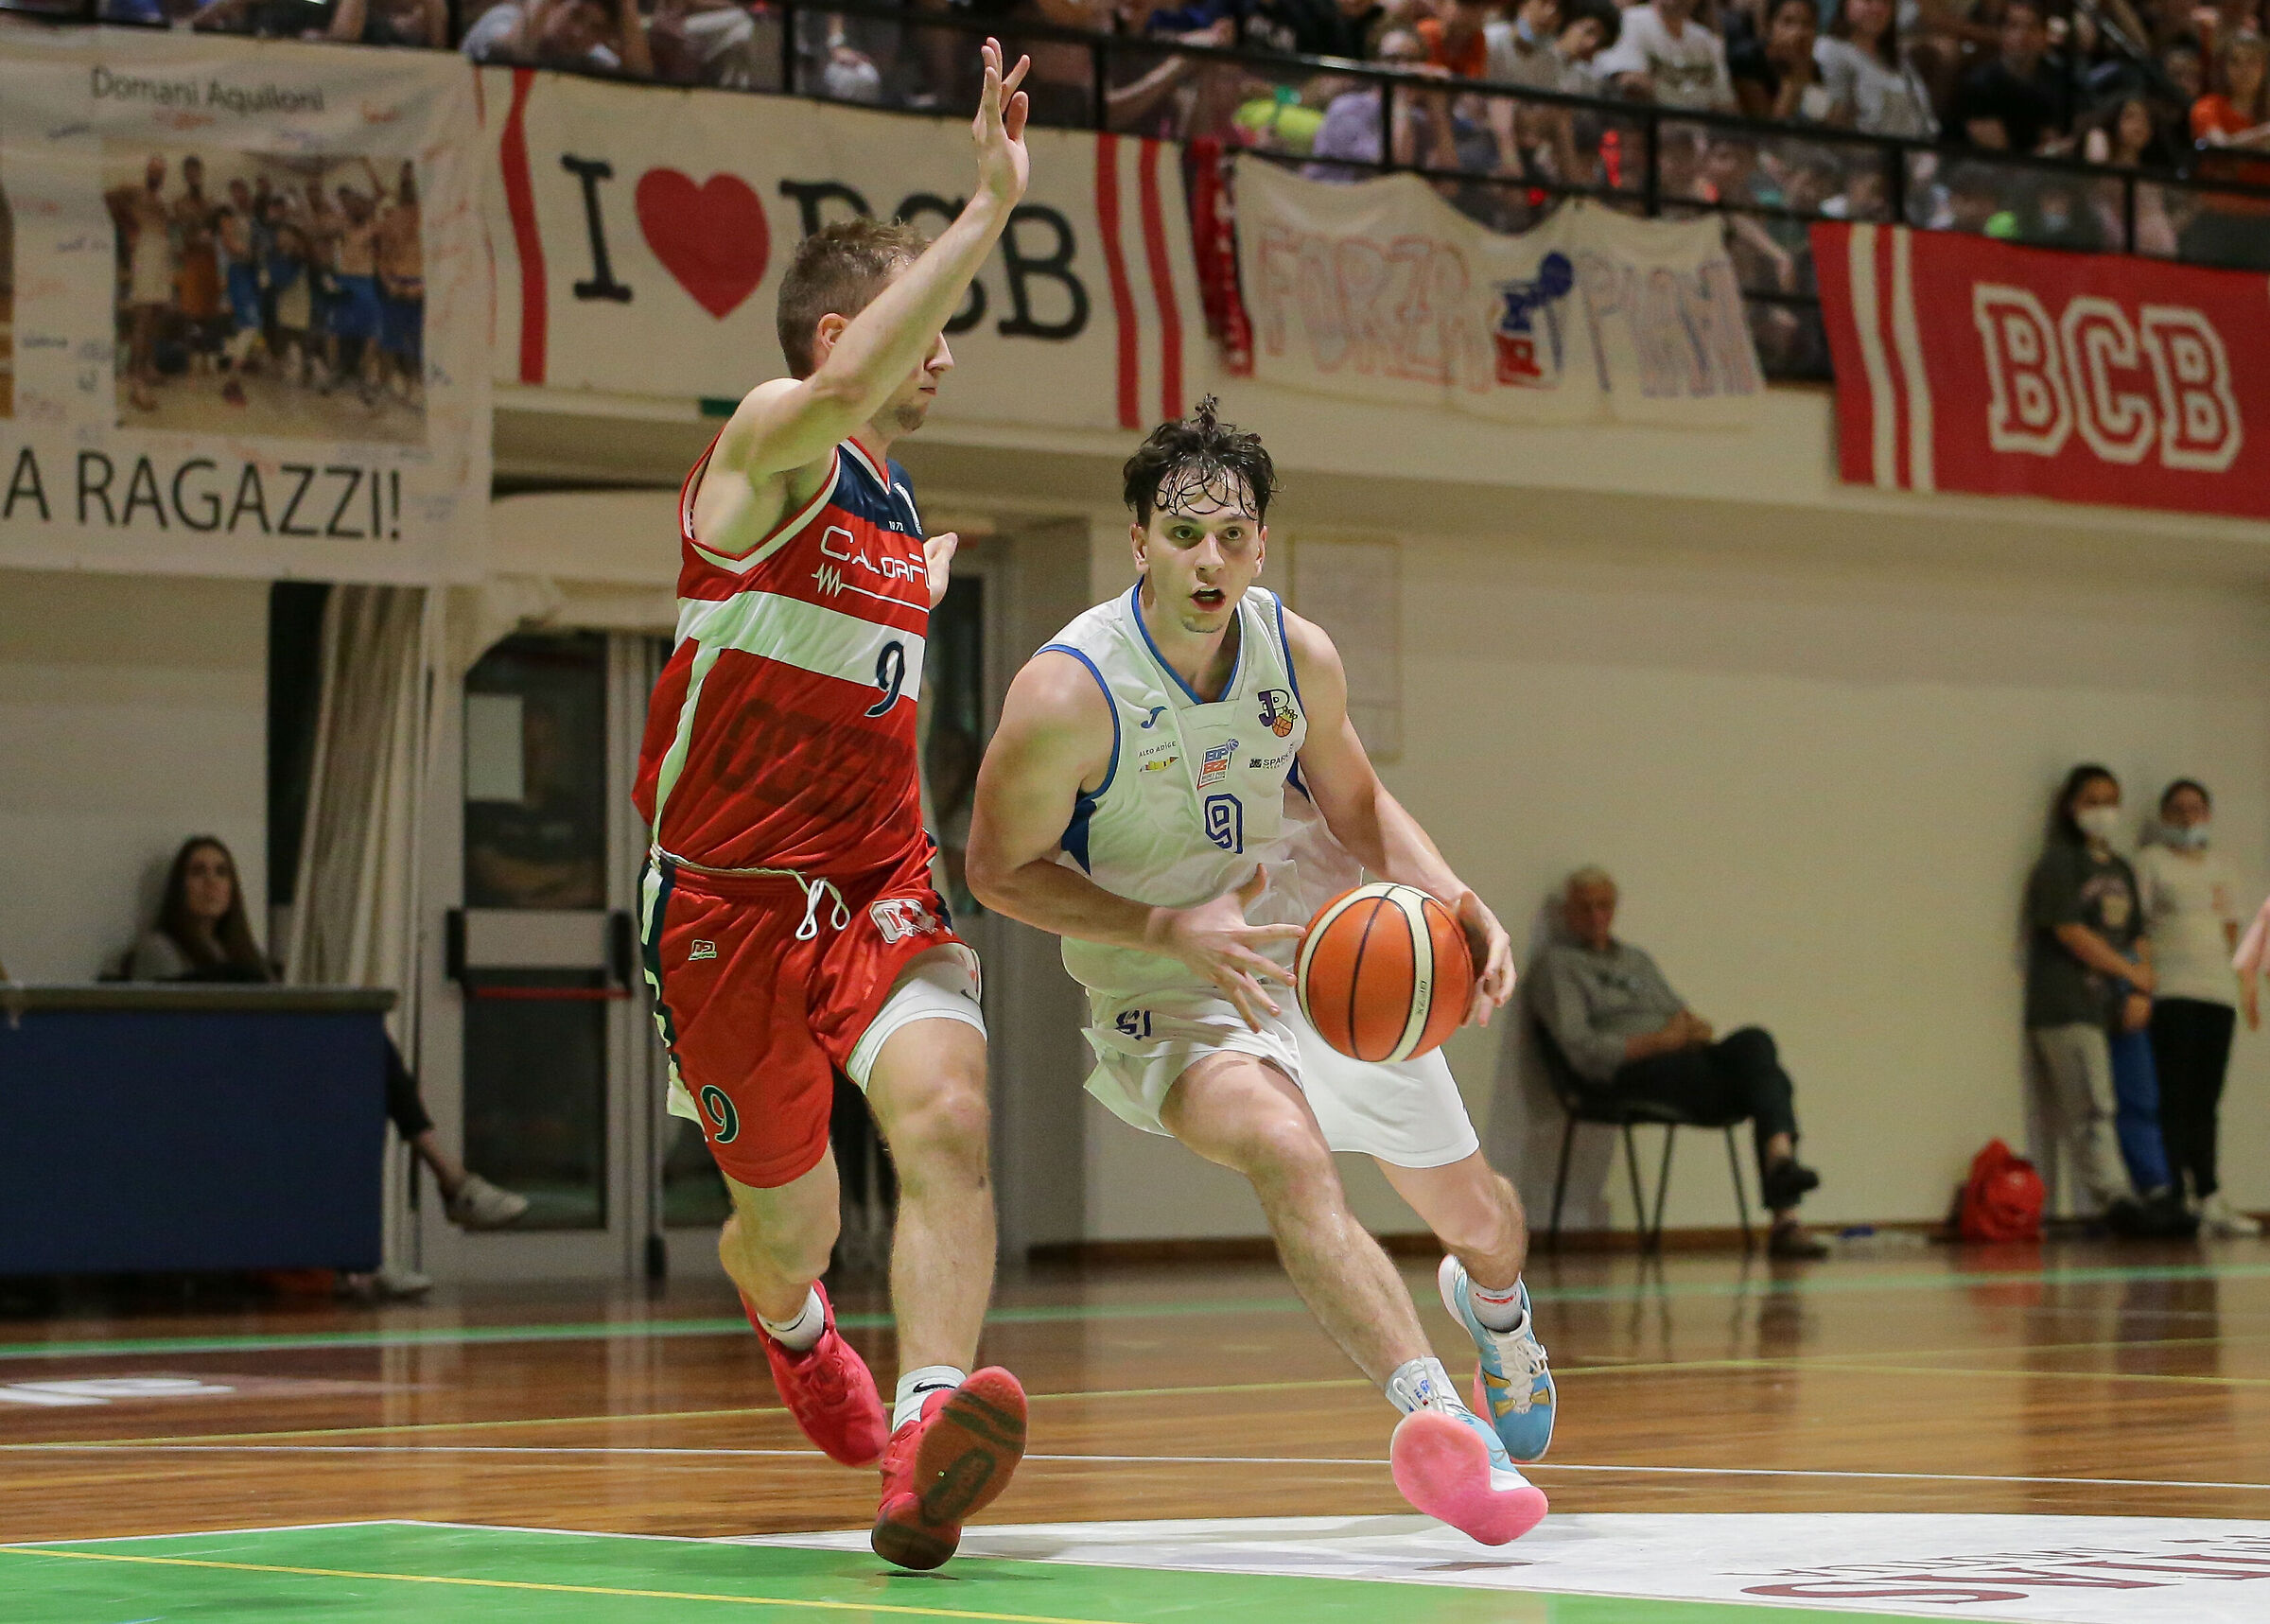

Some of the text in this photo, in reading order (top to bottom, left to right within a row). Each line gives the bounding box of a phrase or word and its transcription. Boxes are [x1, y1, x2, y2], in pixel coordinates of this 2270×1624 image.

[562, 152, 634, 305] I
[1973, 283, 2244, 471] BCB
[77, 450, 401, 541] RAGAZZI!
[864, 640, 905, 718] 9
[1204, 793, 1244, 855] 9
[700, 1084, 740, 1144] 9
